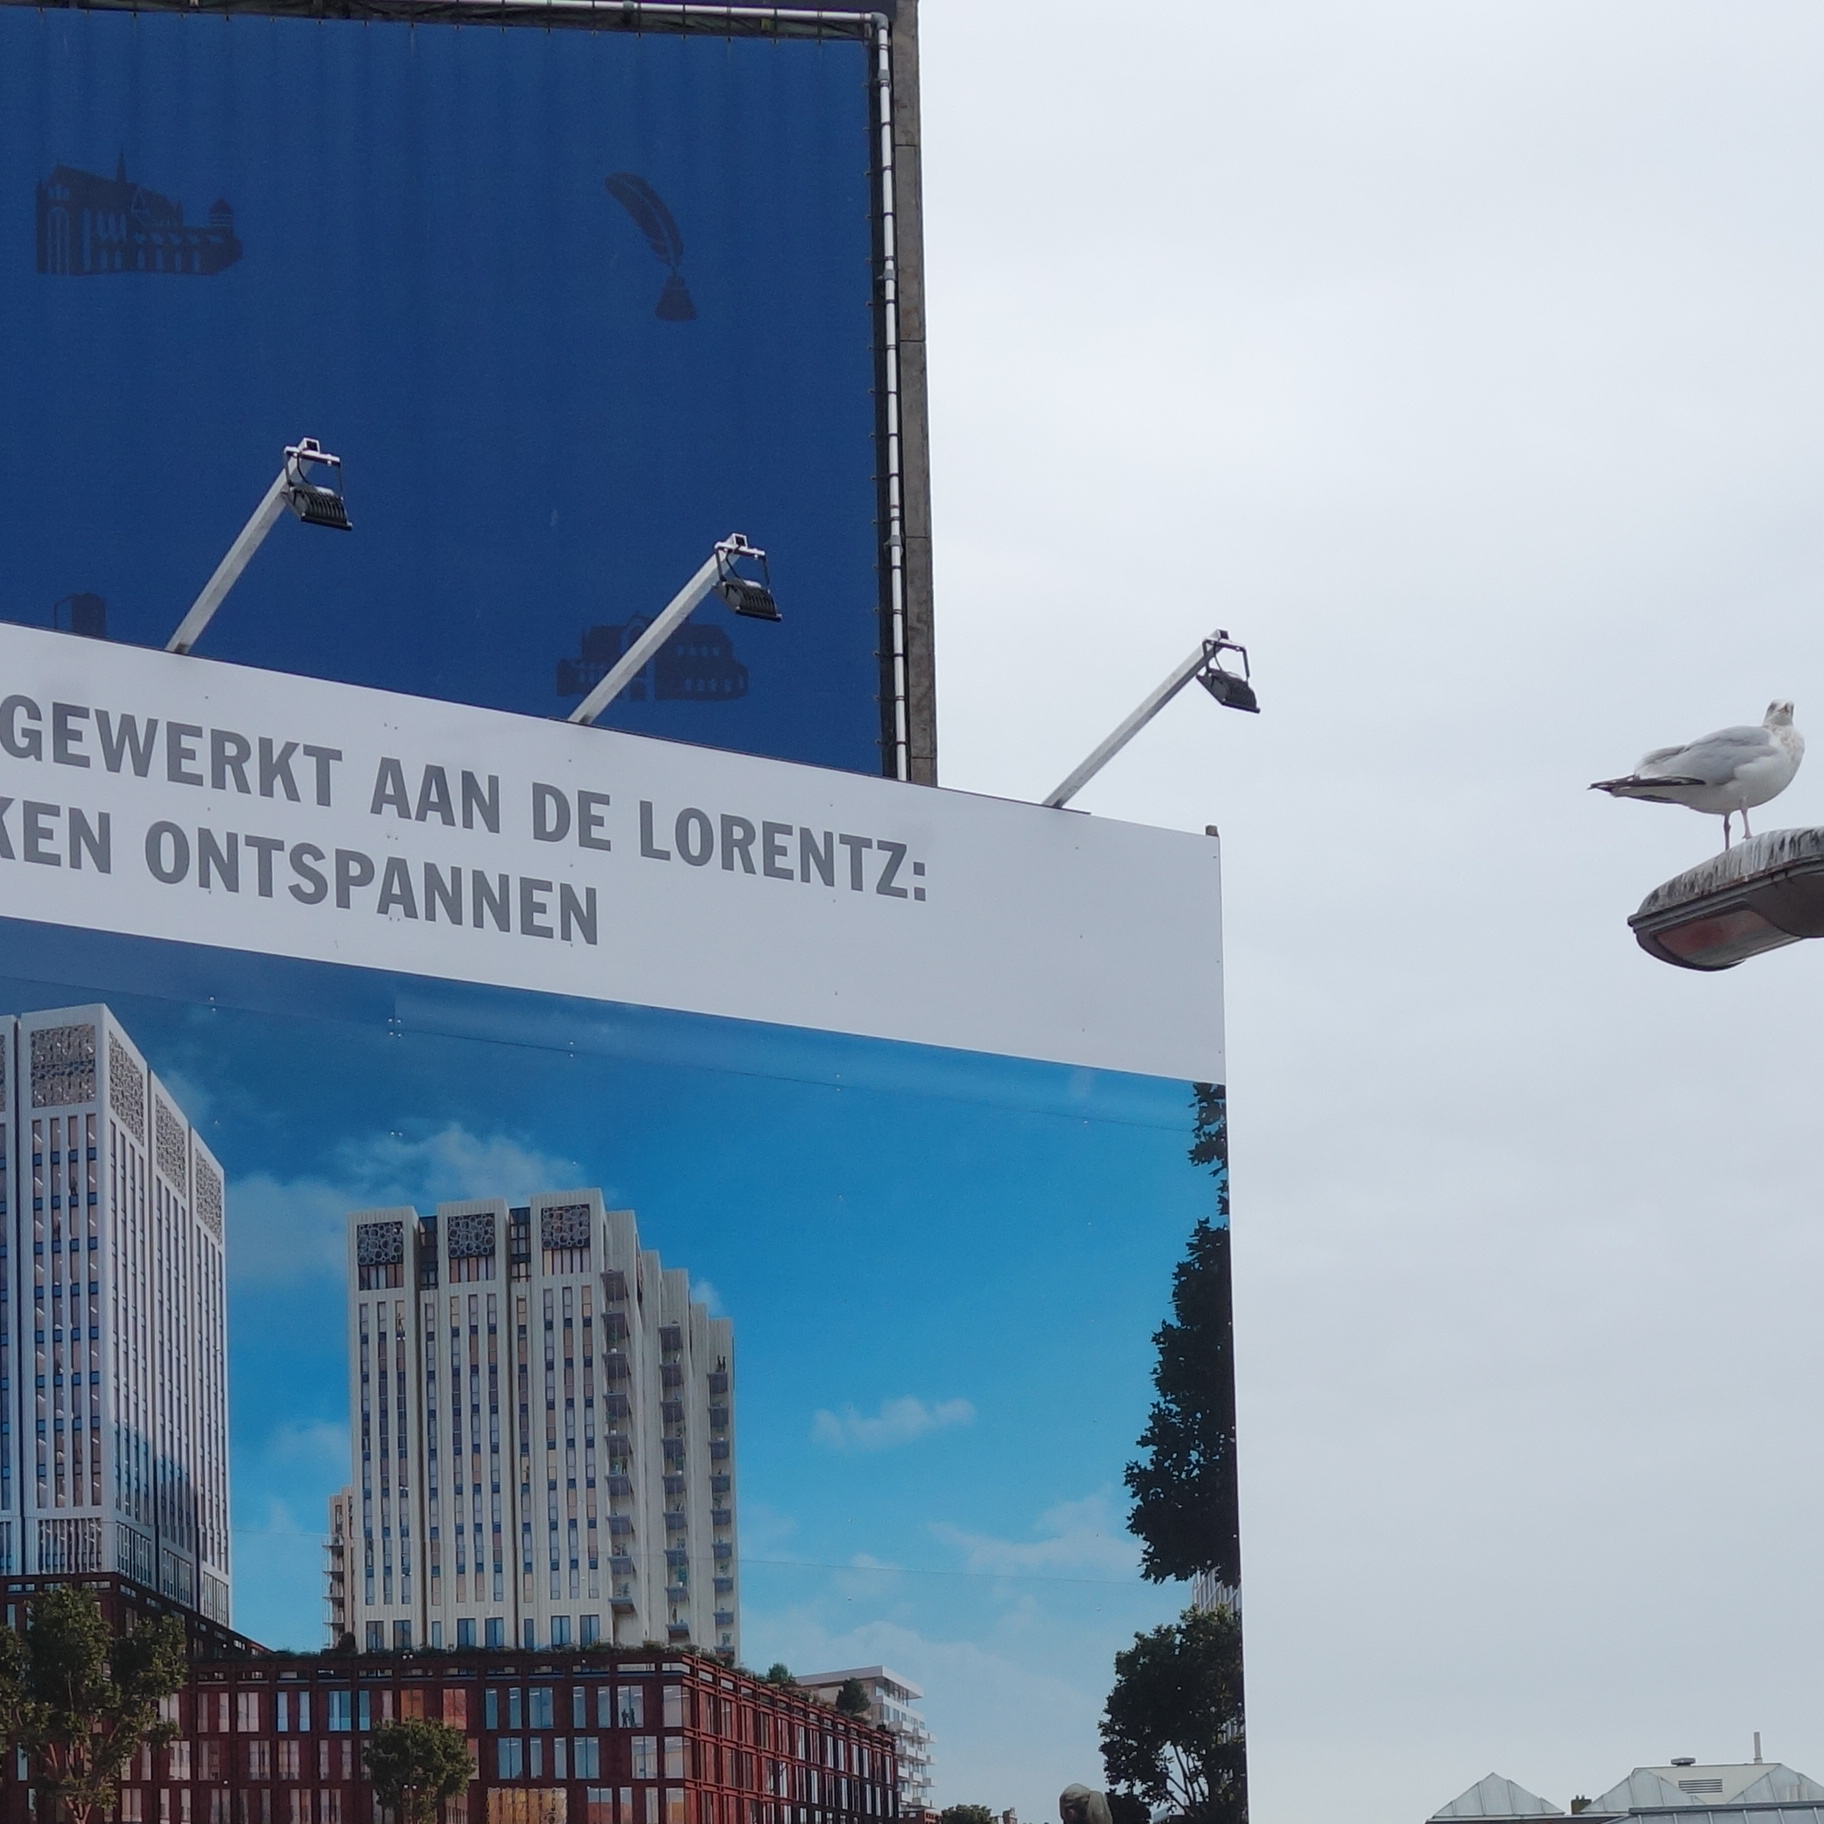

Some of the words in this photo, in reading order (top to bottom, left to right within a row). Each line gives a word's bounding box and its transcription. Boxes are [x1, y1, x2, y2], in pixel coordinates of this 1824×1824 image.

[145, 820, 598, 945] ONTSPANNEN
[371, 756, 501, 834] AAN
[533, 782, 612, 852] DE
[639, 801, 927, 901] LORENTZ:
